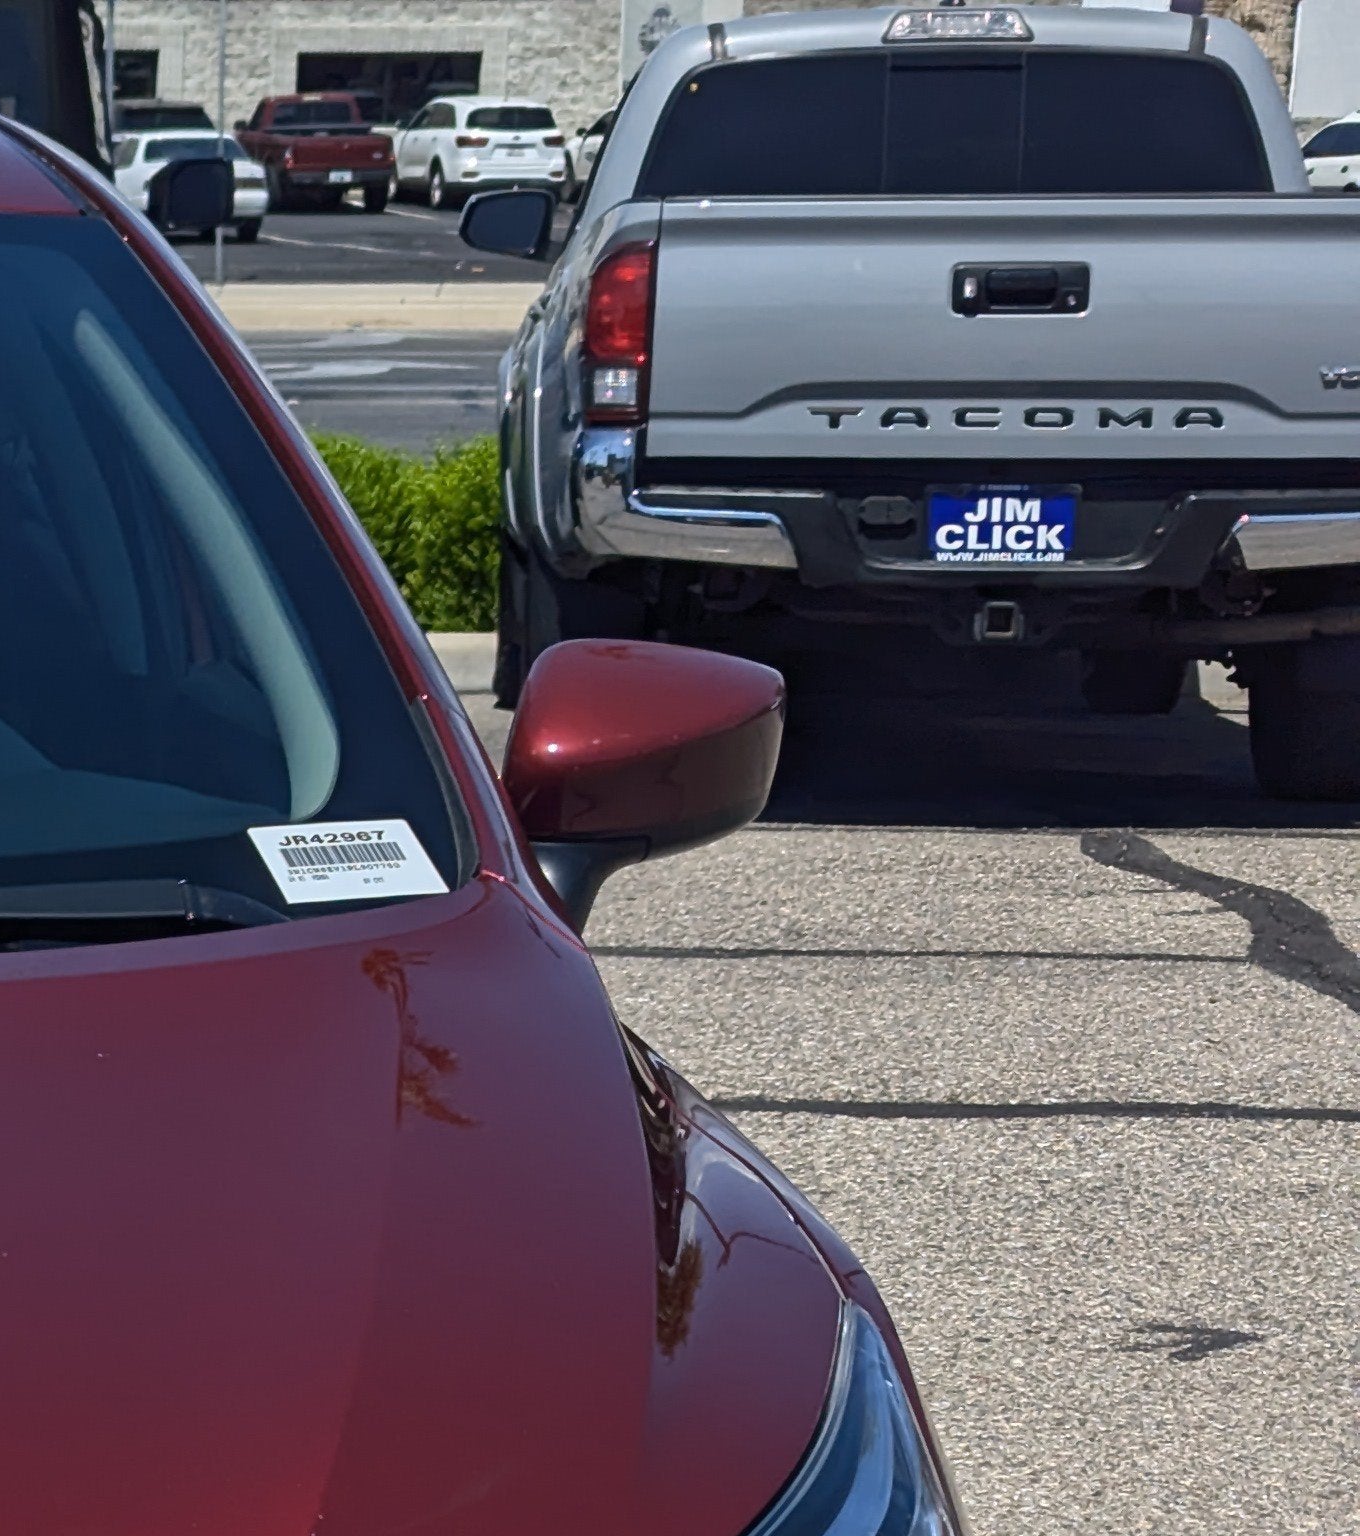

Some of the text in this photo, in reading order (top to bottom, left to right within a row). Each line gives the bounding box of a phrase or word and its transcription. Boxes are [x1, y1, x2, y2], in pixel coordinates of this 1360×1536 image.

[807, 406, 1226, 430] TACOMA
[964, 497, 1041, 523] JIM
[935, 524, 1065, 550] CLICK
[279, 830, 386, 847] JR42967
